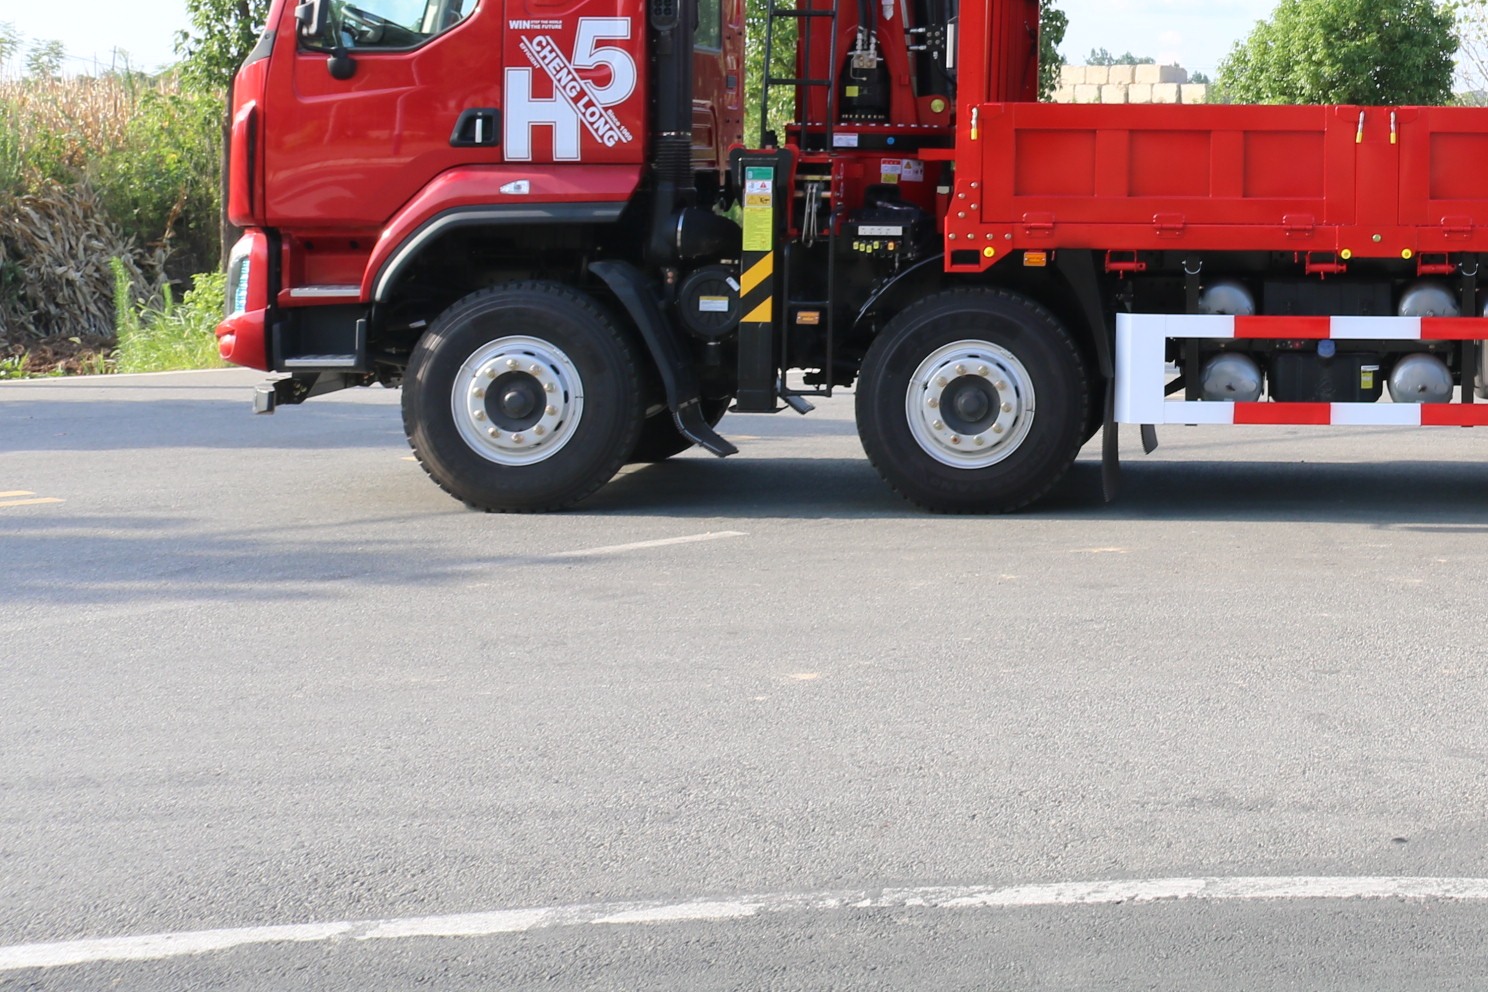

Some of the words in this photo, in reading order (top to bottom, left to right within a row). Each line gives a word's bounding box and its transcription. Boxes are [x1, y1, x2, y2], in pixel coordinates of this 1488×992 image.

[509, 19, 531, 30] WIN
[532, 35, 581, 97] CHENG
[577, 95, 619, 148] LONG
